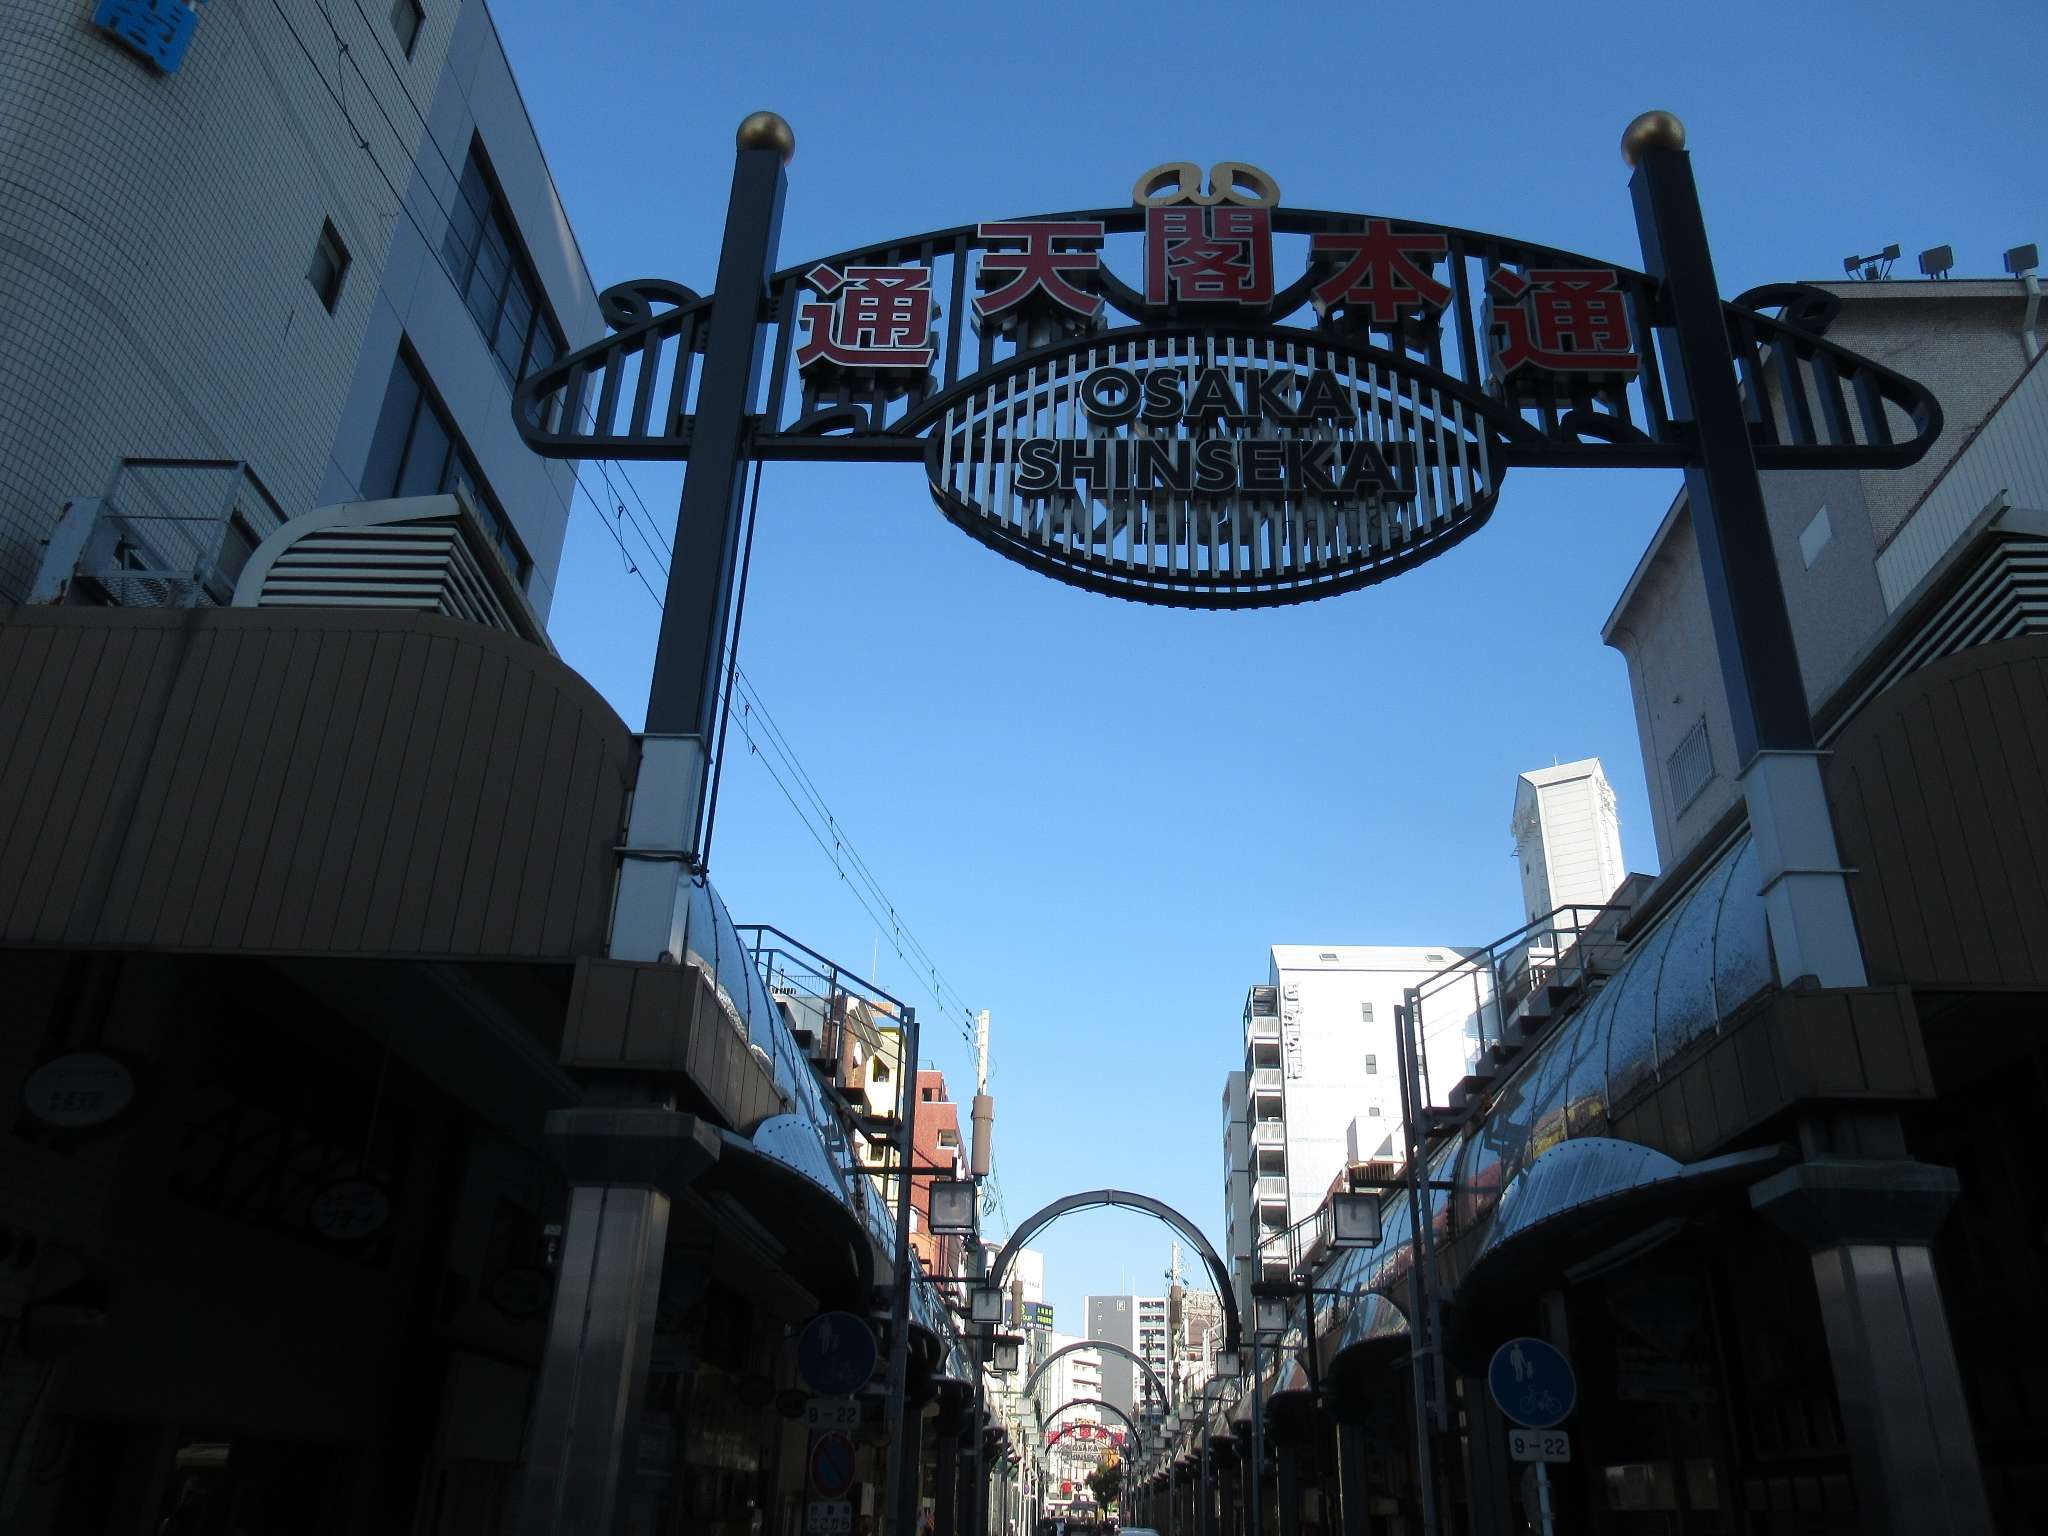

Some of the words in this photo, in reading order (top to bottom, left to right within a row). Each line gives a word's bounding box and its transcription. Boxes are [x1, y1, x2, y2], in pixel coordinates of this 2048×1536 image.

[798, 205, 1639, 373] 通天閣本通
[1080, 366, 1356, 423] OSAKA
[1014, 438, 1416, 494] SHINSEKAI
